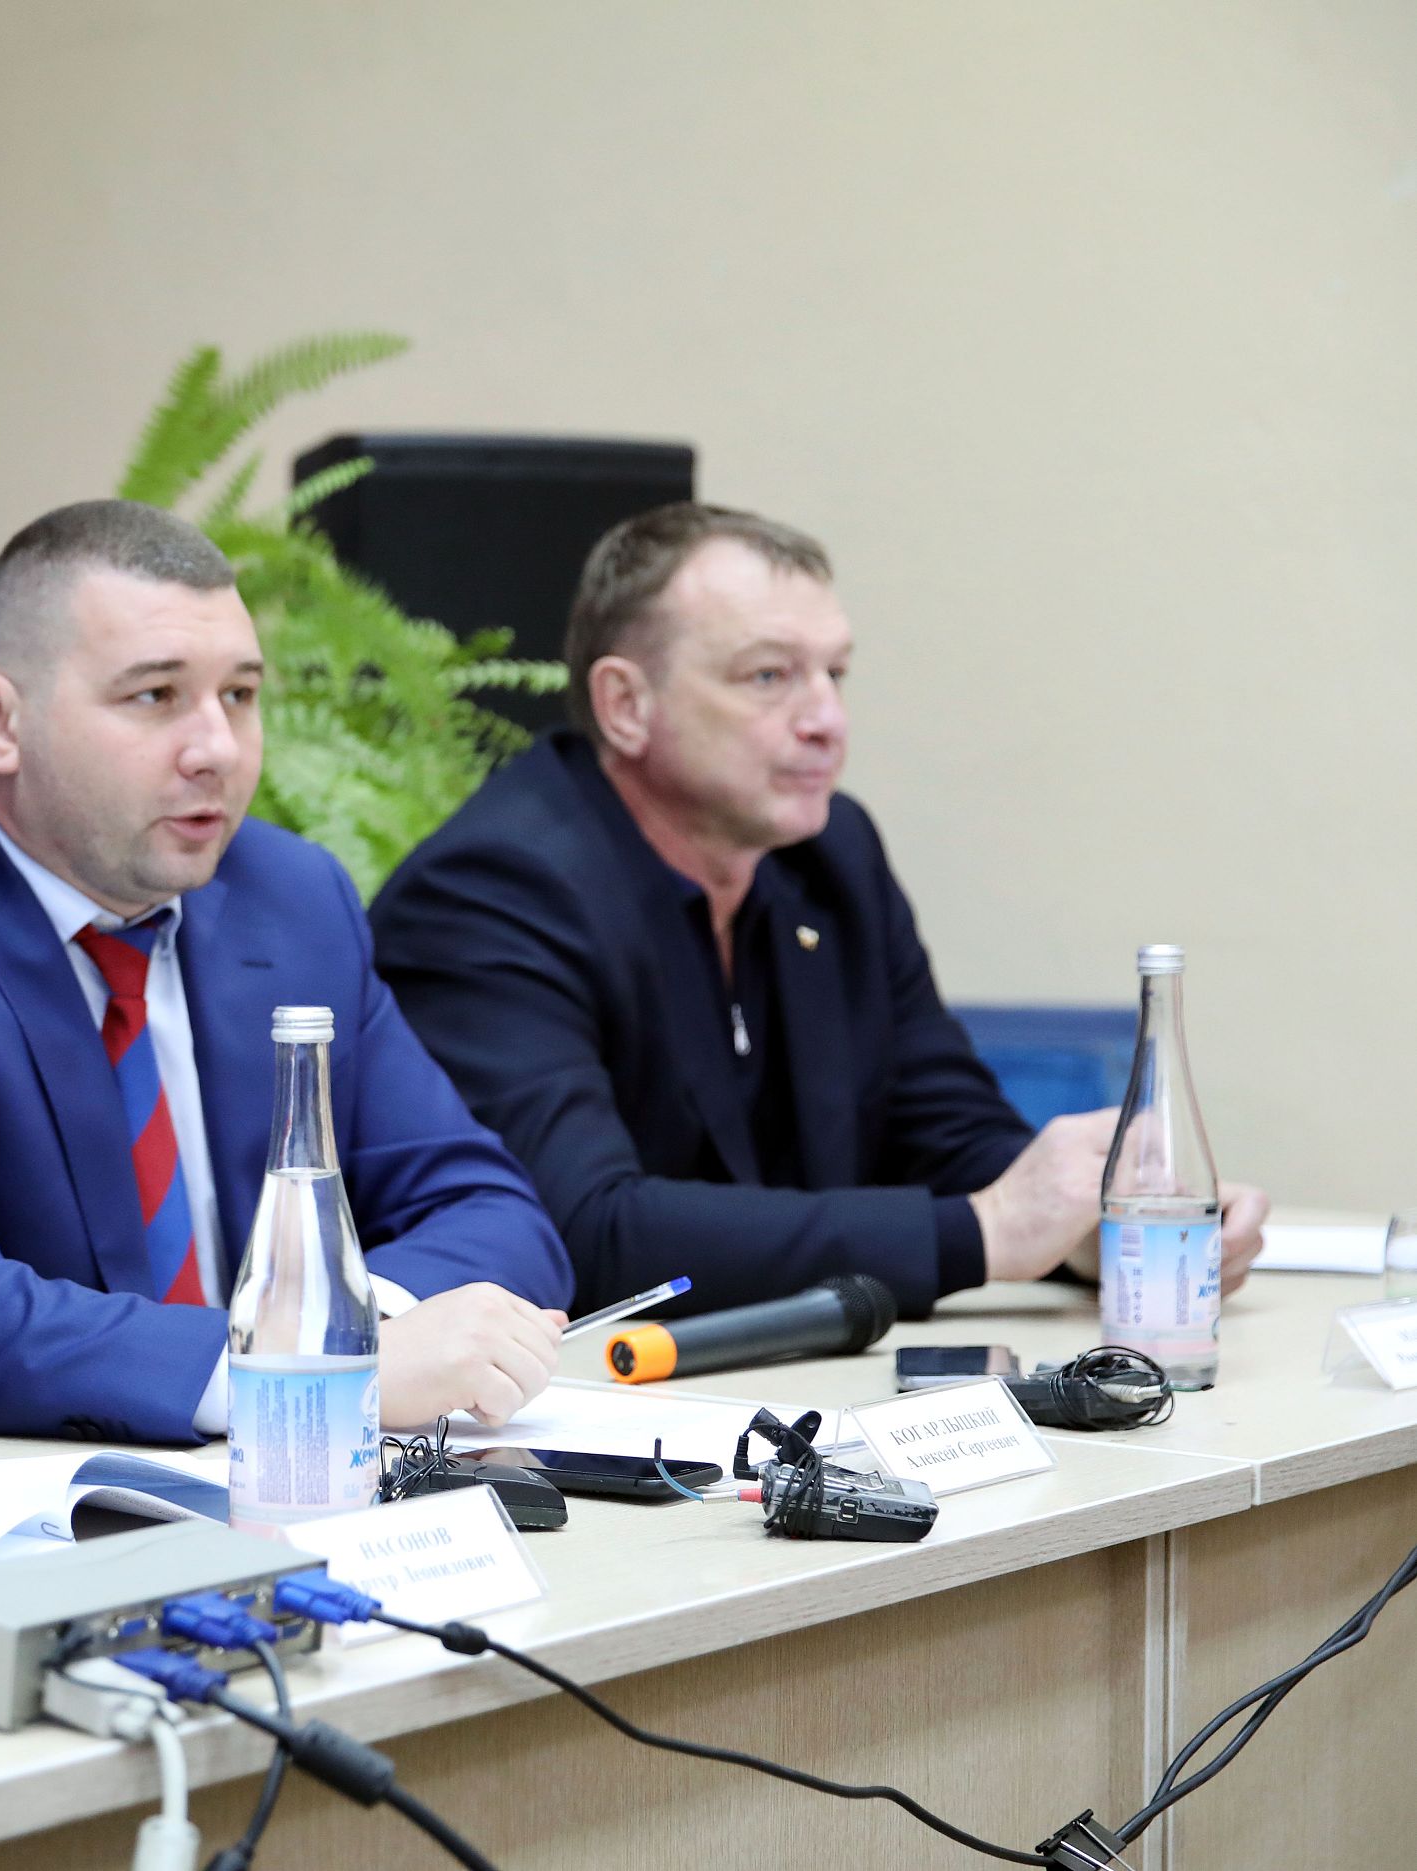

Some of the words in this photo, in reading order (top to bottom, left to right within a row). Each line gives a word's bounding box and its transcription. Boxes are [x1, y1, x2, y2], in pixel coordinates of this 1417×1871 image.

[889, 1406, 1001, 1446] КОГАРЛЫЦКИЙ
[906, 1444, 960, 1470] Алексей
[957, 1435, 1021, 1458] Сергеевич
[358, 1526, 453, 1561] НАСОНОВ
